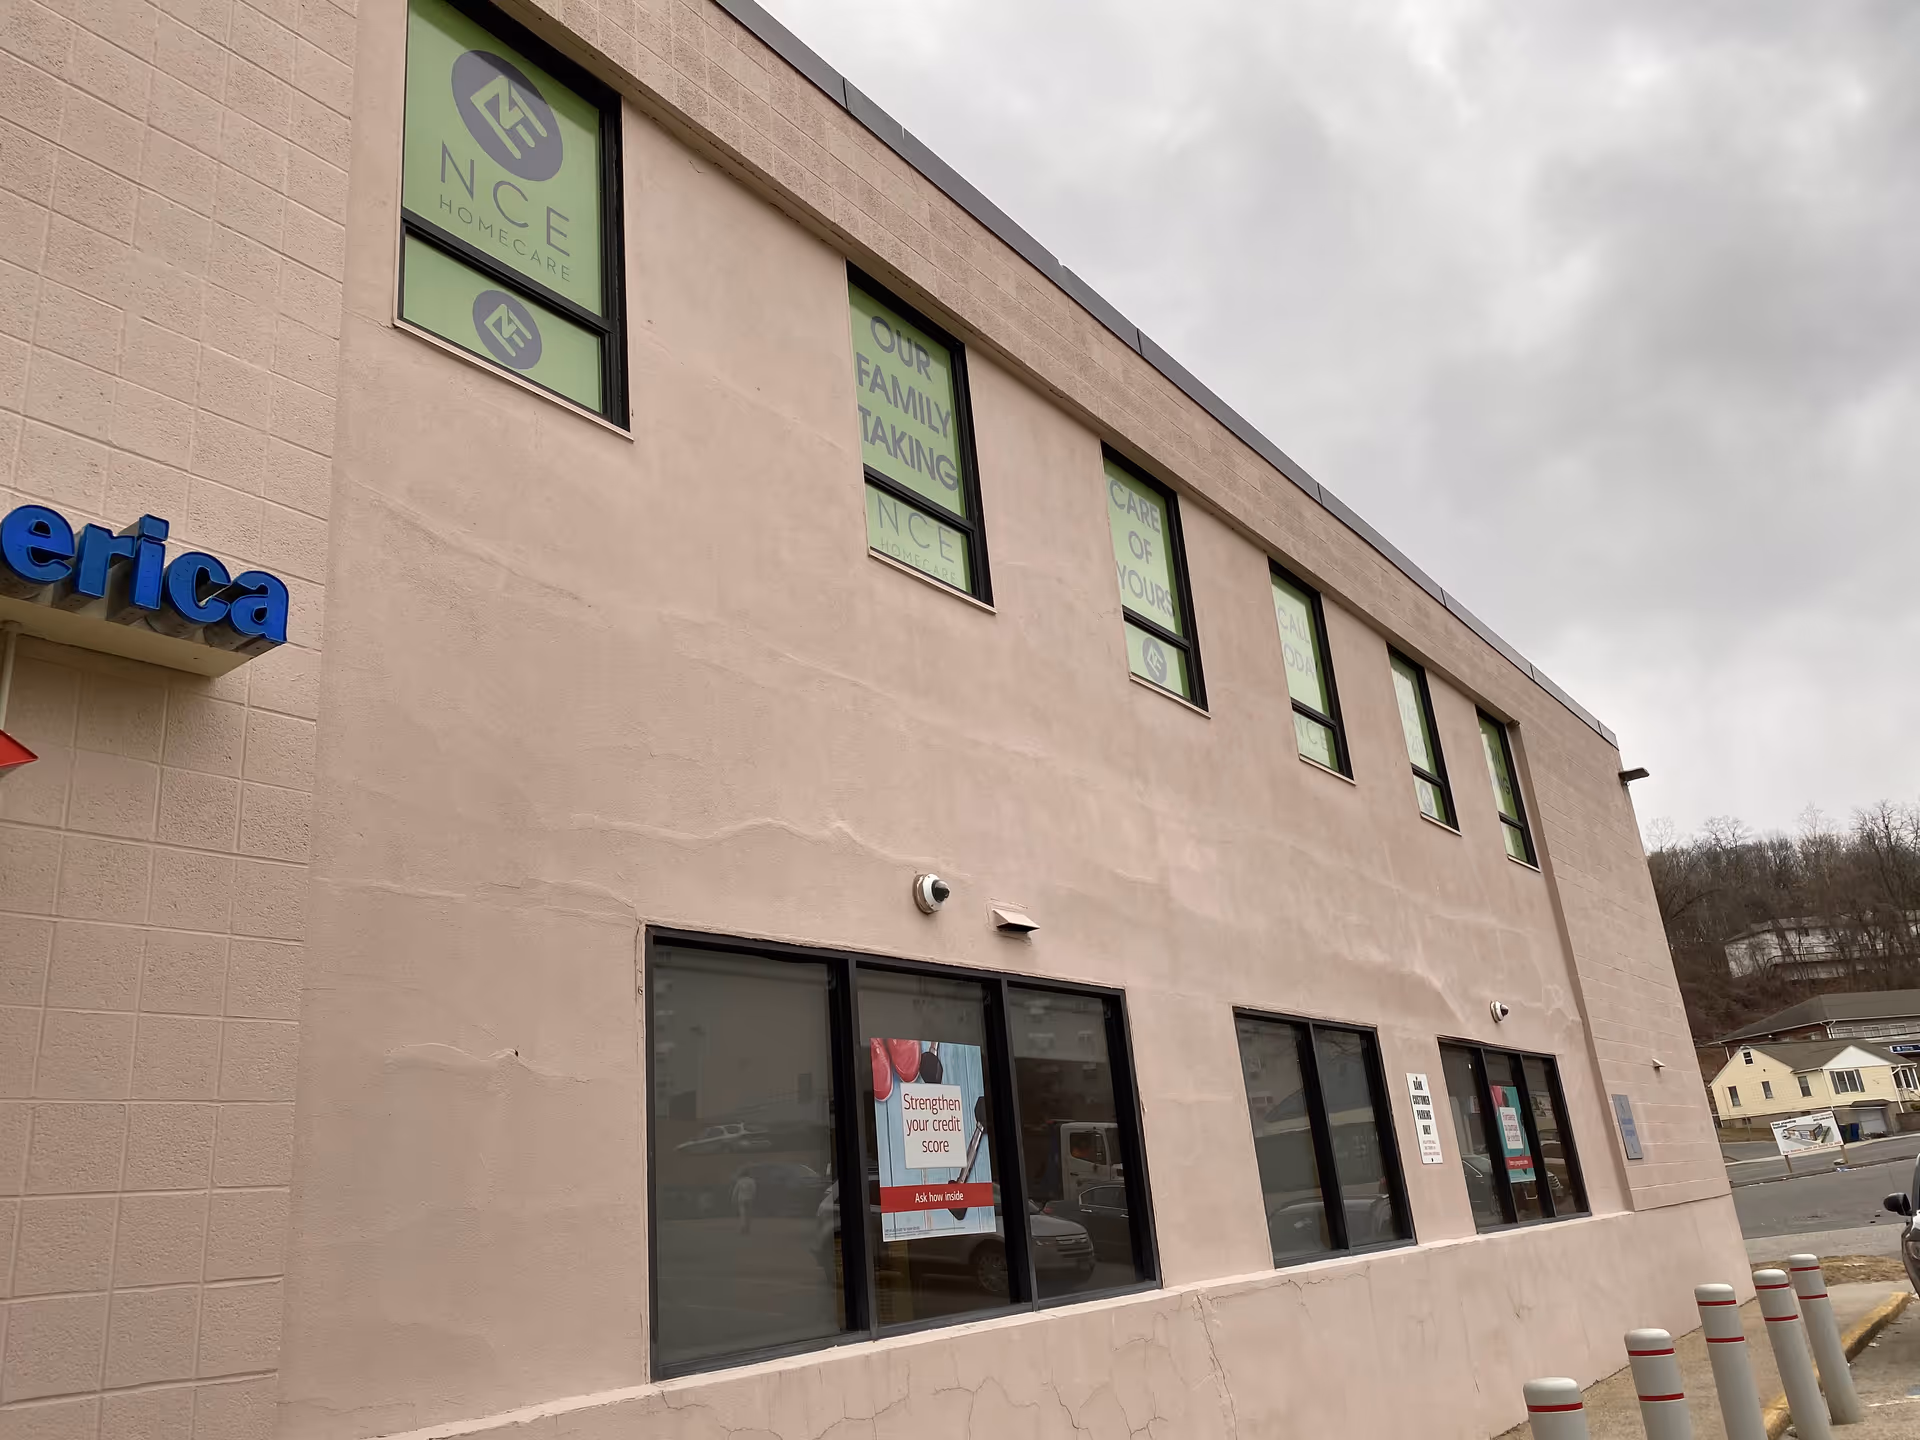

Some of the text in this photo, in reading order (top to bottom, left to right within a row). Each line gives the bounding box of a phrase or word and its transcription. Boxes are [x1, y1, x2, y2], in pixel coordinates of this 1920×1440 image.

[440, 140, 571, 257] NCE
[439, 194, 571, 282] HOMECARE
[870, 315, 932, 383] OUR
[856, 351, 951, 439] FAMILY
[858, 403, 959, 492] TAKING
[876, 492, 955, 564] NCE
[1109, 479, 1161, 535] CARE
[880, 535, 956, 586] HOMECARE
[1128, 530, 1153, 565] OF
[1116, 560, 1175, 619] YOURS
[1278, 606, 1310, 644] CALL
[903, 1093, 961, 1115] Strengthen
[906, 1116, 961, 1136] your credit
[921, 1139, 950, 1153] score
[914, 1189, 964, 1203] Ask how inside
